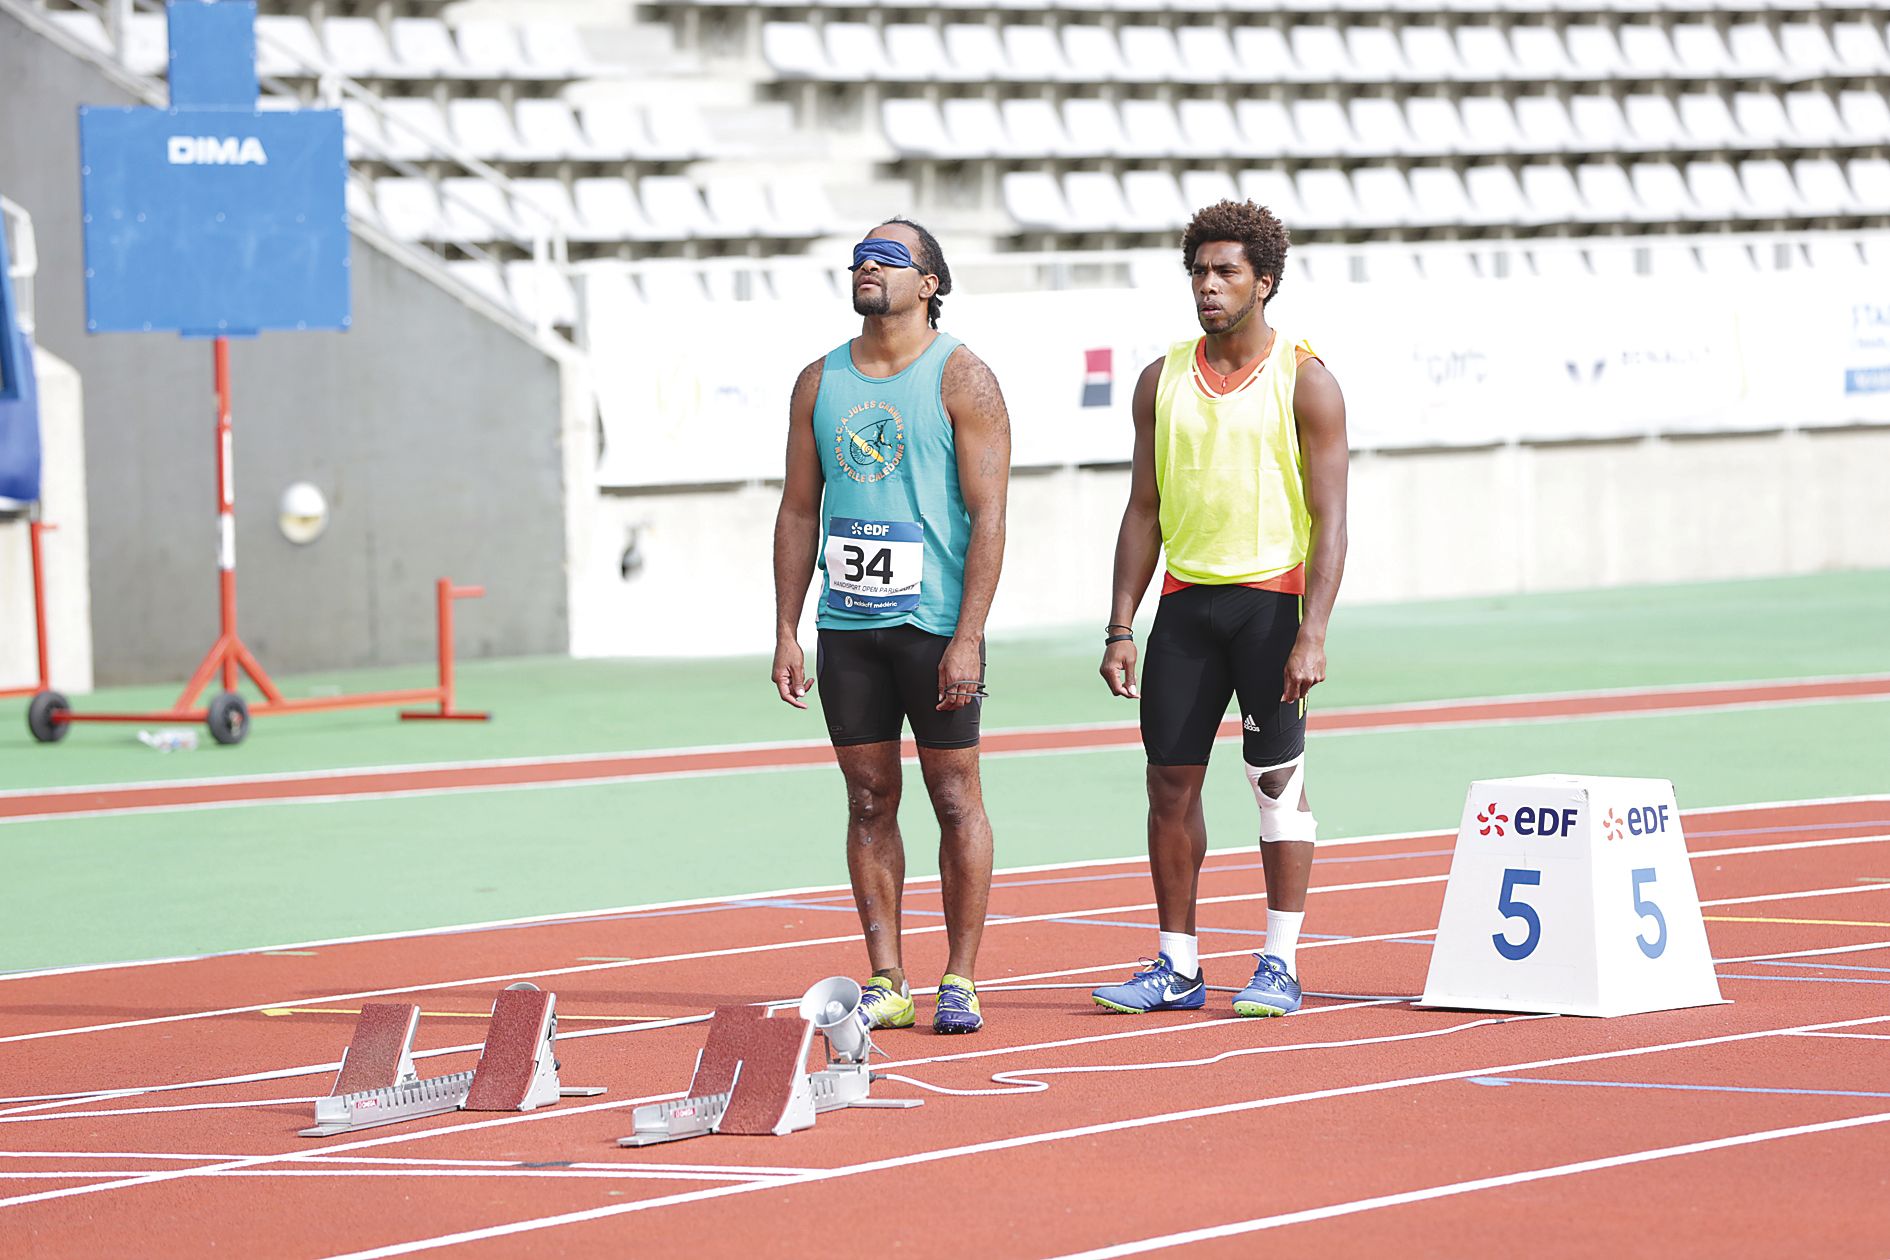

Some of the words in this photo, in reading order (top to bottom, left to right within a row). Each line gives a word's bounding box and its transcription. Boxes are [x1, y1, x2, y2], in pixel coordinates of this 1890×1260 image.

[167, 135, 268, 166] DIMA
[848, 400, 876, 417] JULES
[834, 446, 866, 483] NOUVELLE
[842, 544, 894, 585] 34
[862, 585, 878, 593] OPEN
[1492, 868, 1541, 961] 5
[1631, 867, 1667, 960] 5
